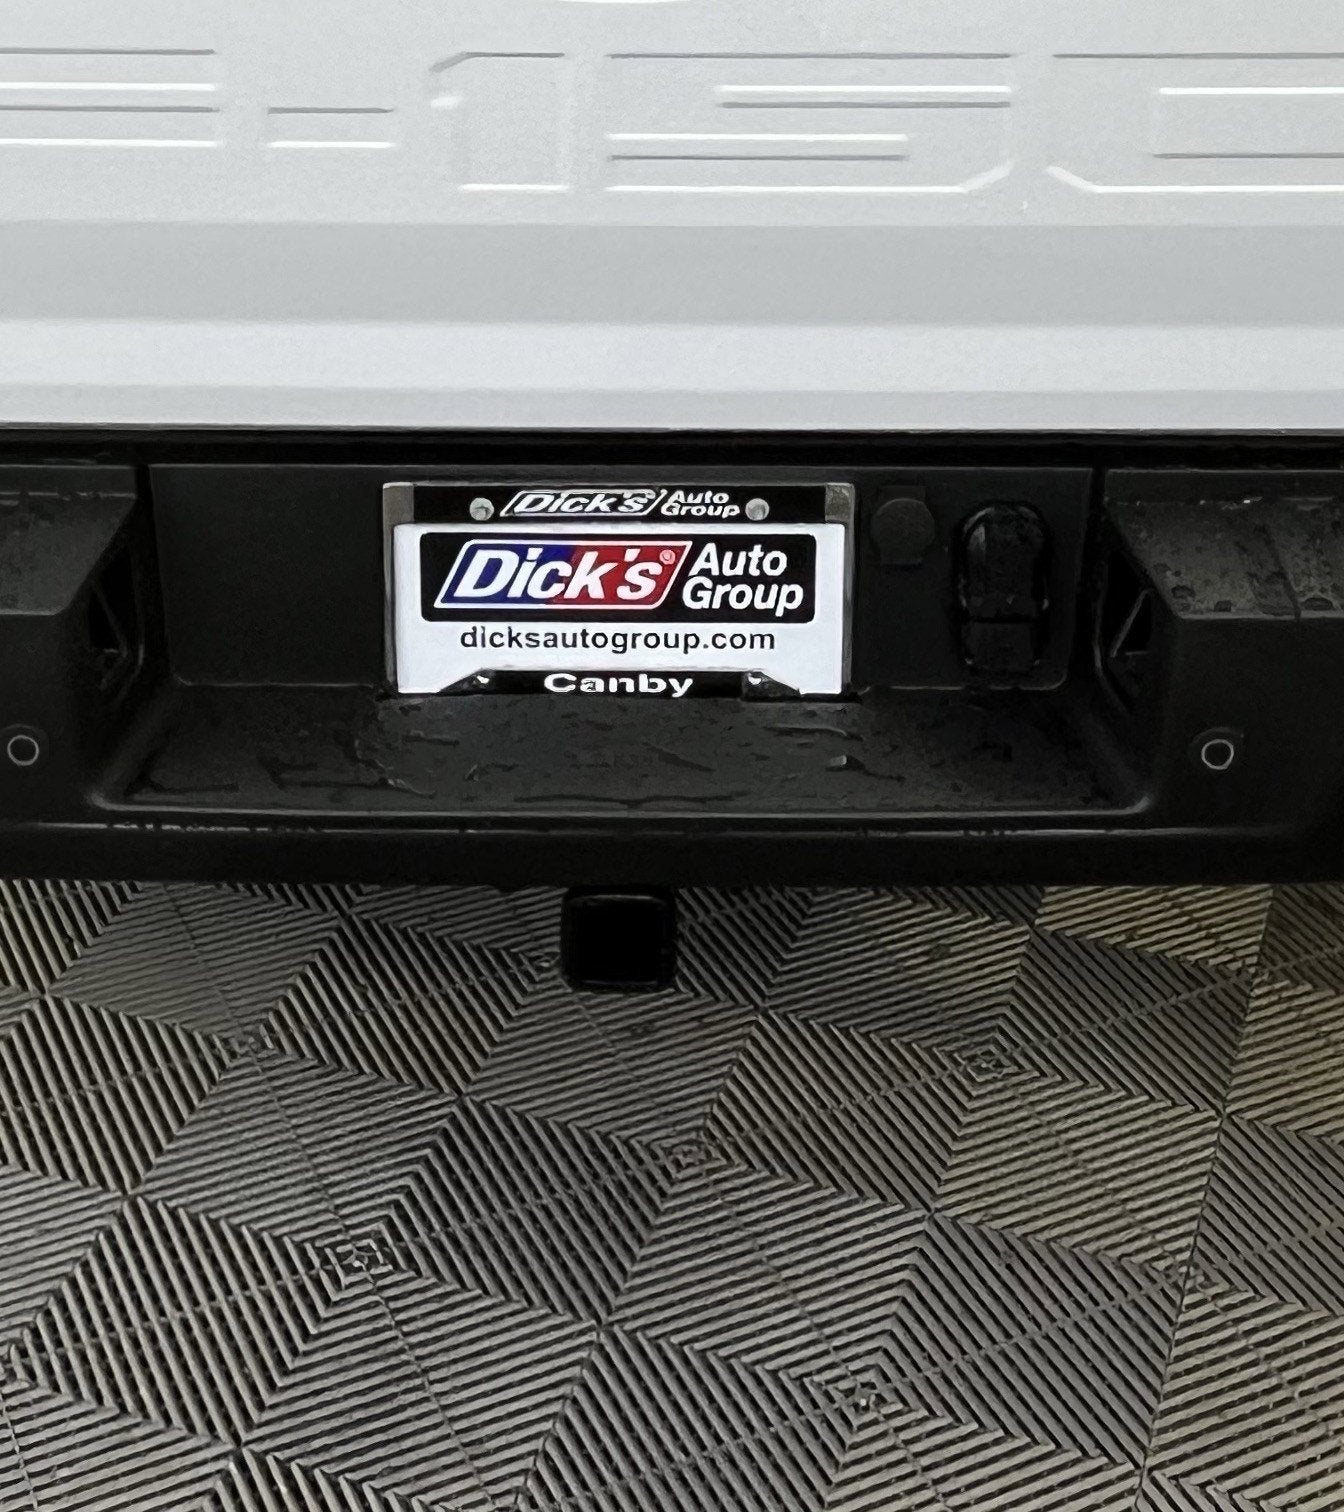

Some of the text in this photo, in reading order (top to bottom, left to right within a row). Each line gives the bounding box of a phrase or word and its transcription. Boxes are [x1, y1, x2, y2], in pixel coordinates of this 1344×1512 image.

[661, 502, 741, 519] Group
[672, 489, 731, 504] Auto
[688, 543, 788, 577] Auto
[682, 576, 805, 618] Group
[460, 625, 776, 655] dicksautogroup.com
[543, 672, 694, 699] Canby
